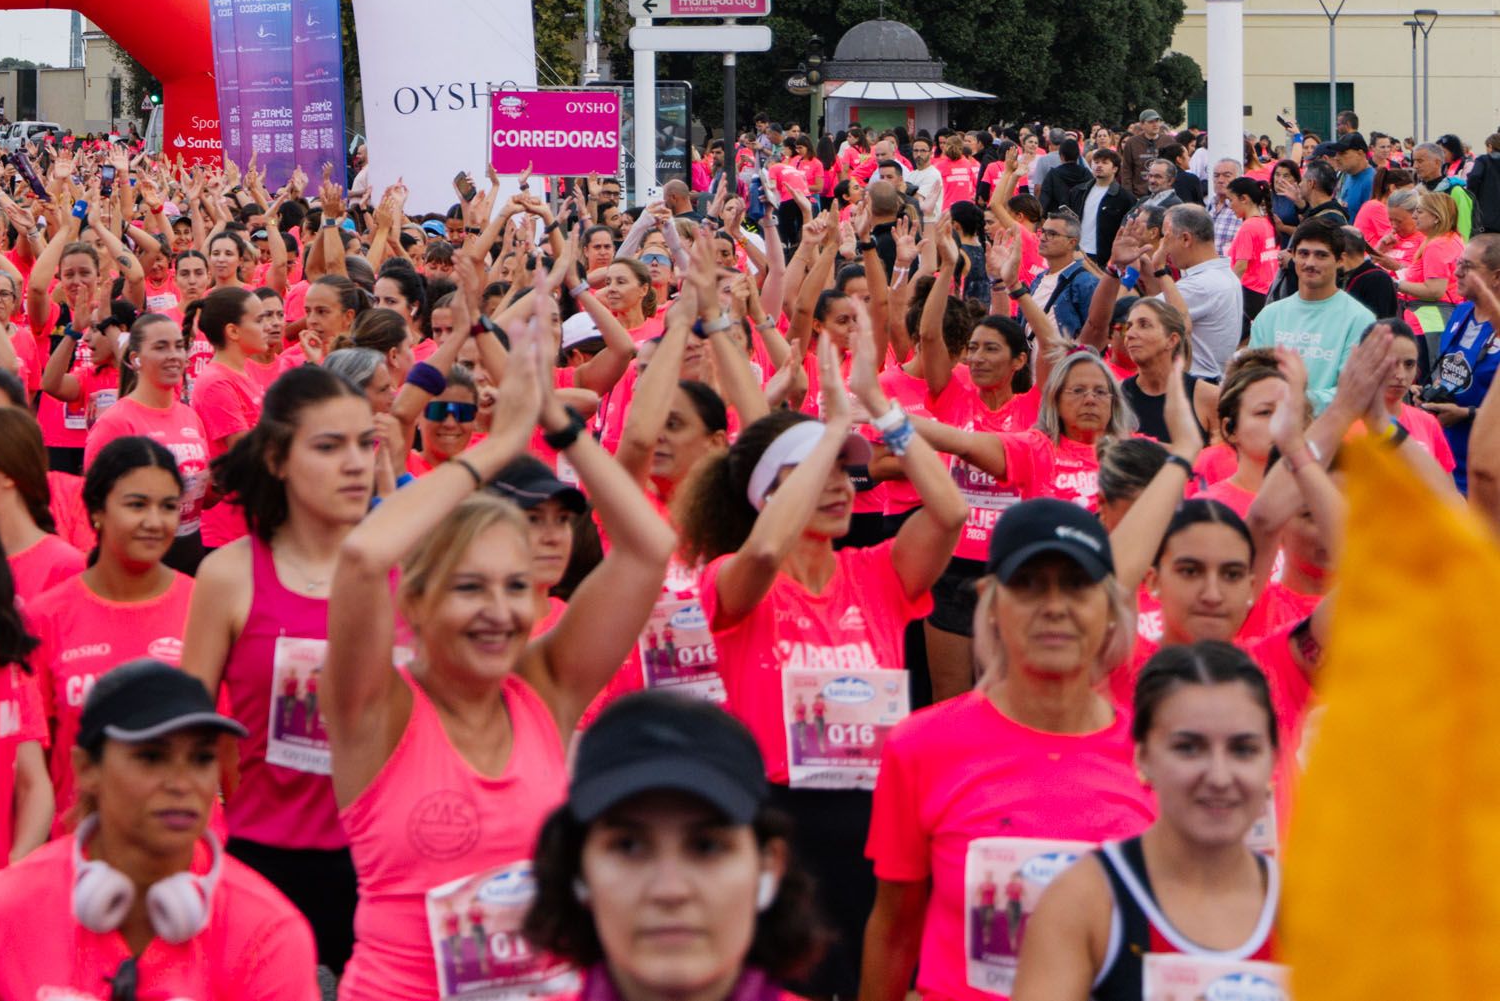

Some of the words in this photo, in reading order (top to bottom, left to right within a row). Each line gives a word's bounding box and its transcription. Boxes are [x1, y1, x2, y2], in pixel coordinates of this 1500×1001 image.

[565, 101, 616, 114] OYSHO
[191, 115, 220, 132] Spor
[187, 136, 222, 150] Santa
[492, 129, 617, 149] CORREDORAS
[1442, 360, 1468, 378] Estrella
[61, 642, 111, 661] OYSHO
[828, 724, 876, 745] 016
[490, 931, 527, 960] 01
